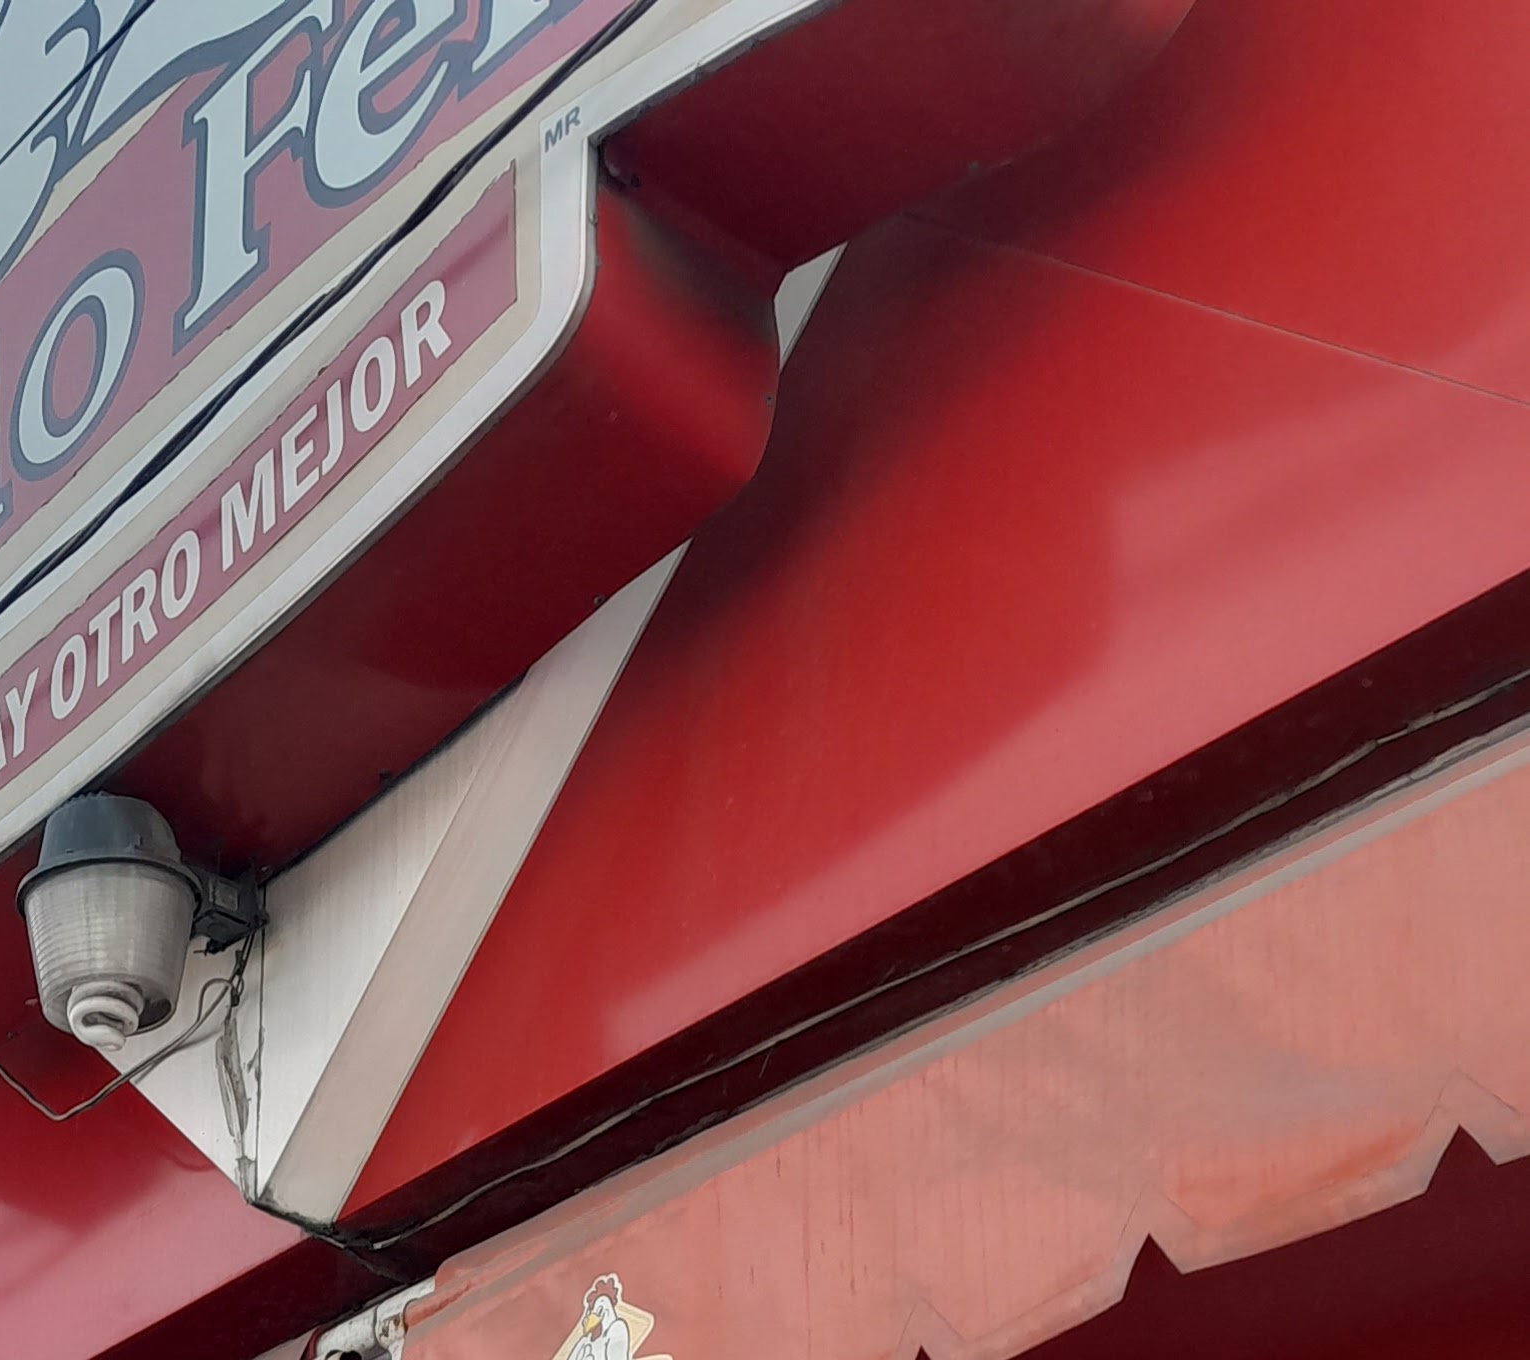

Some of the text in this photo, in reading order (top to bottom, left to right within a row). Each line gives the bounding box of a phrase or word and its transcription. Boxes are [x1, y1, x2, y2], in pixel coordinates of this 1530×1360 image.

[172, 0, 555, 355] Fe
[542, 105, 583, 152] MR
[48, 531, 201, 720] OTRO
[220, 279, 452, 571] MEJOR
